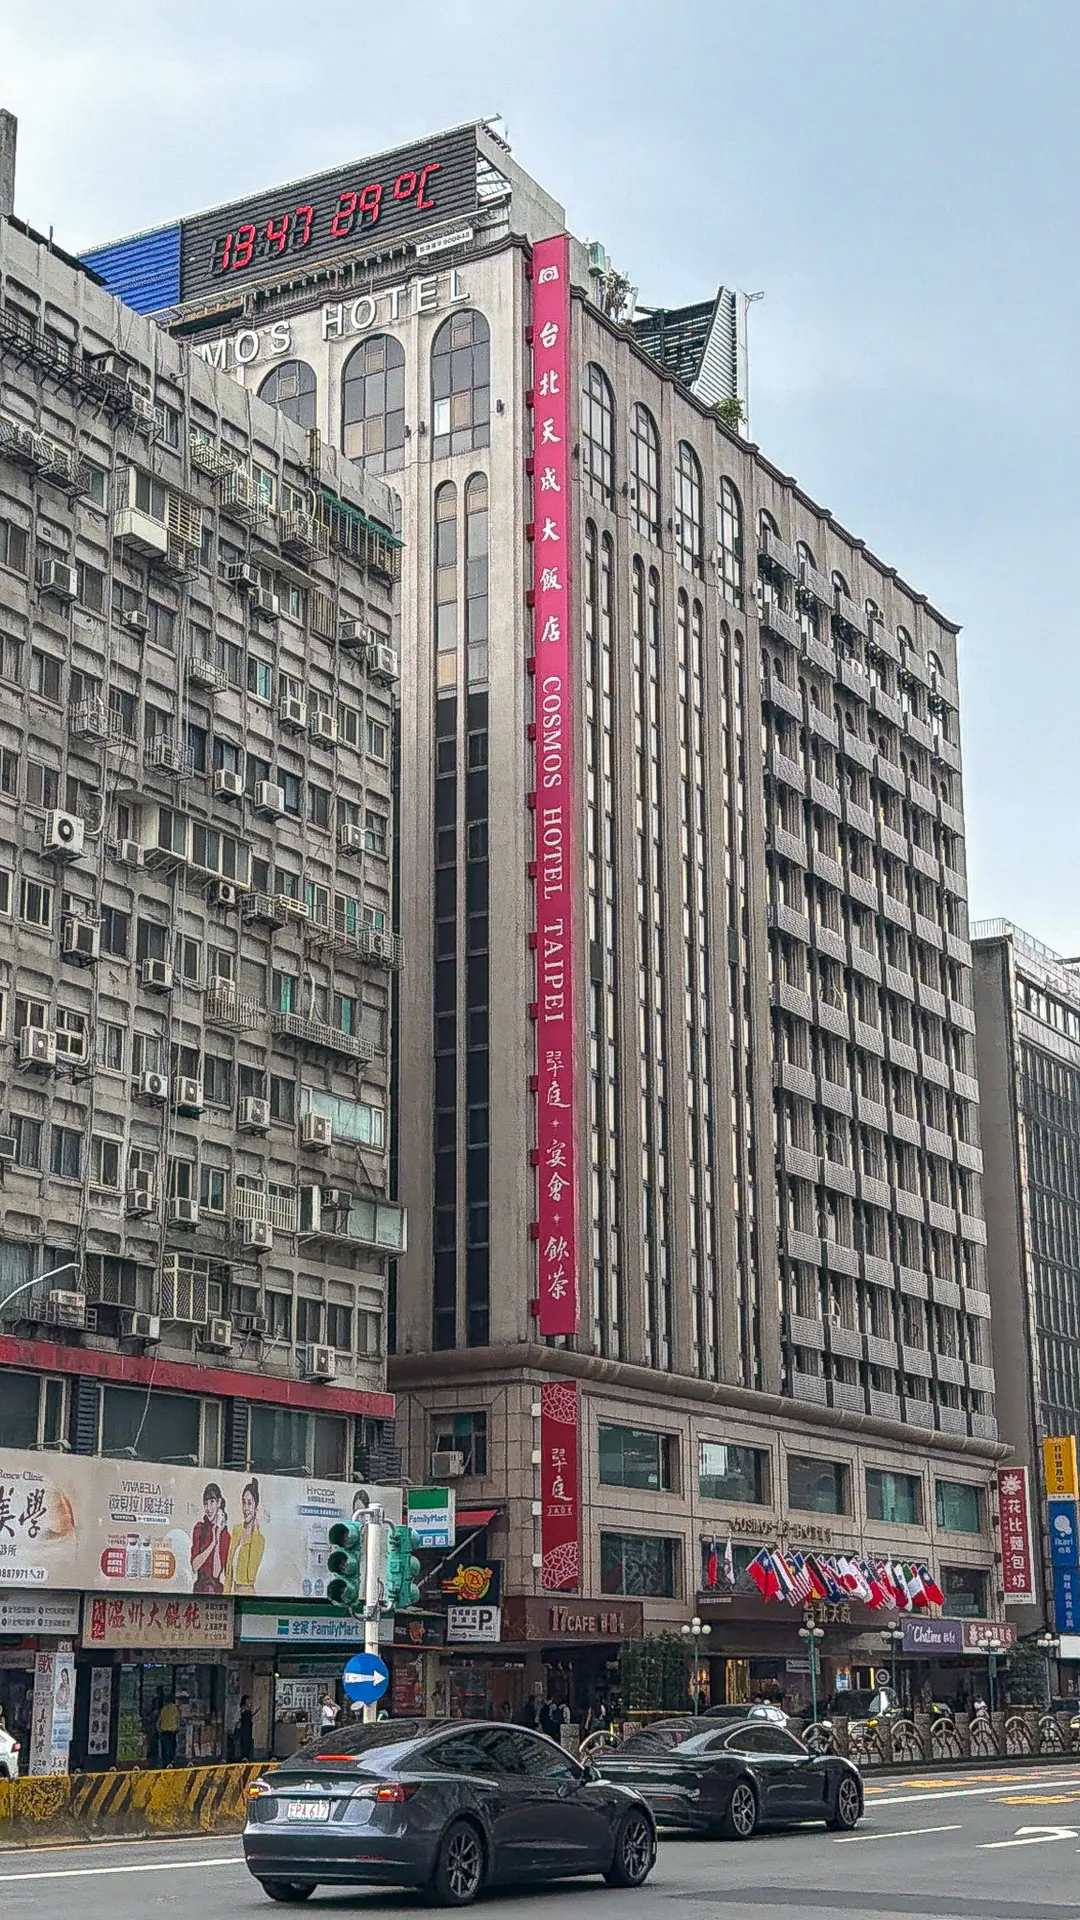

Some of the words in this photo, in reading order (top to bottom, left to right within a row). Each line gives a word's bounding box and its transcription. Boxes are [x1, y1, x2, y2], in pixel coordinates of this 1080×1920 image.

[321, 268, 471, 341] HOTEL
[538, 320, 564, 644] 台北天成大飯店
[541, 675, 563, 790] COSMOS
[542, 804, 563, 901] HOTEL
[543, 917, 566, 1024] TAIPEI
[545, 1139, 571, 1203] 宴會
[544, 1235, 571, 1301] 飲茶
[408, 1513, 448, 1525] FamilyMart
[1008, 1498, 1026, 1589] 花比麵包坊
[107, 1598, 201, 1631] 溫州大餛飩
[311, 1620, 360, 1638] FamilyMart
[478, 1609, 493, 1631] P
